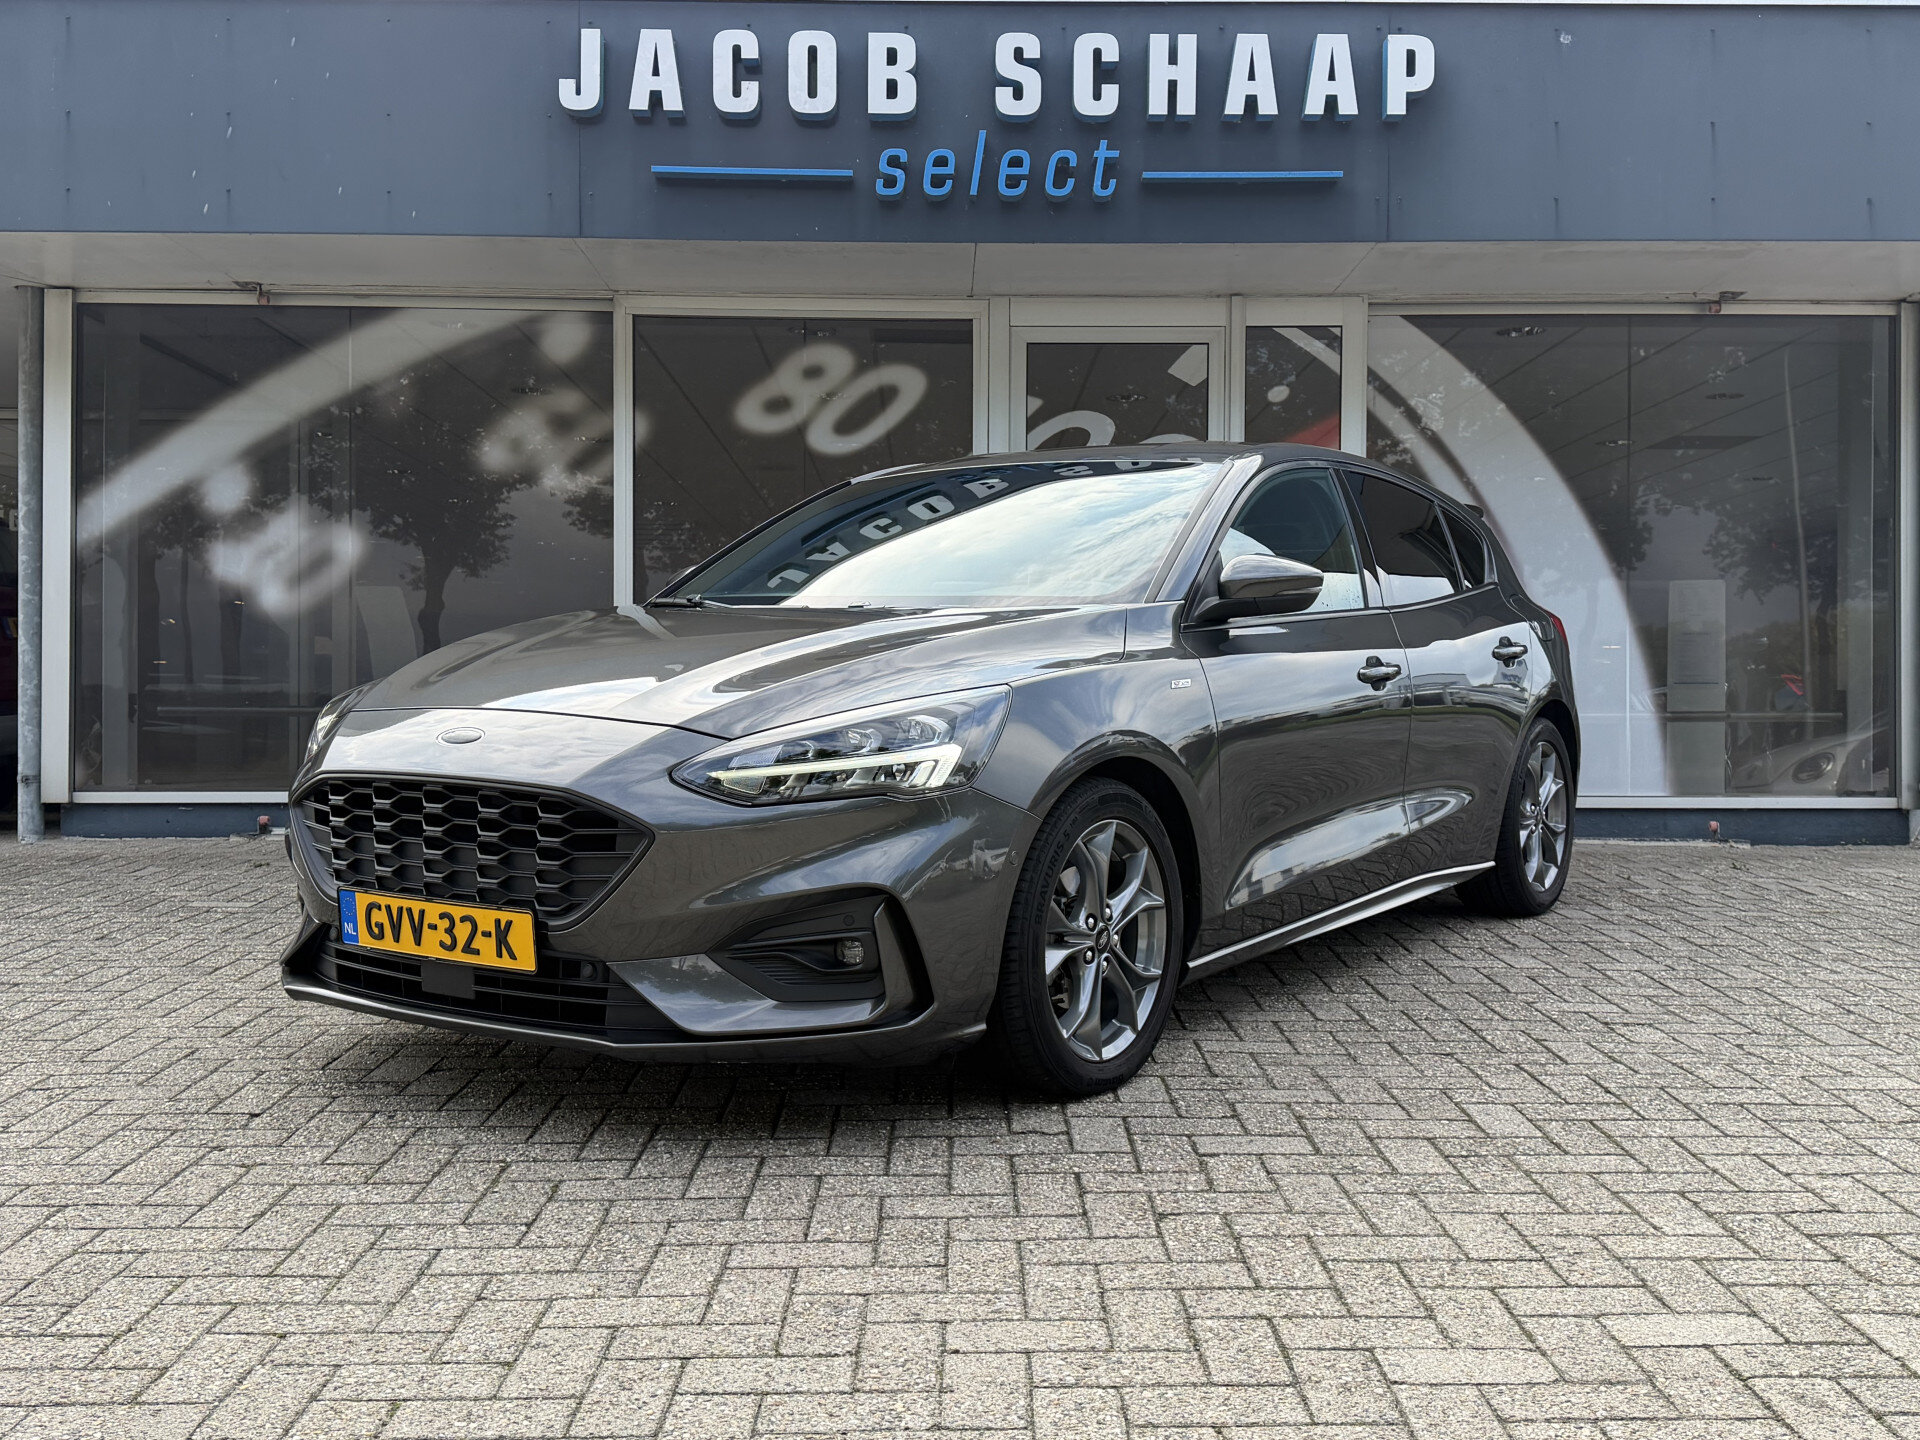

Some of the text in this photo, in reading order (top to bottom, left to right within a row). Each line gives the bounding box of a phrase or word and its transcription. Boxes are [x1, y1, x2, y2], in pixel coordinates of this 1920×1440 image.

[558, 28, 1436, 121] JACOB SCHAAP
[876, 130, 1120, 197] select
[734, 344, 928, 455] 80
[1034, 842, 1065, 926] BRAVURIS
[344, 900, 518, 962] NL GVV-32-K
